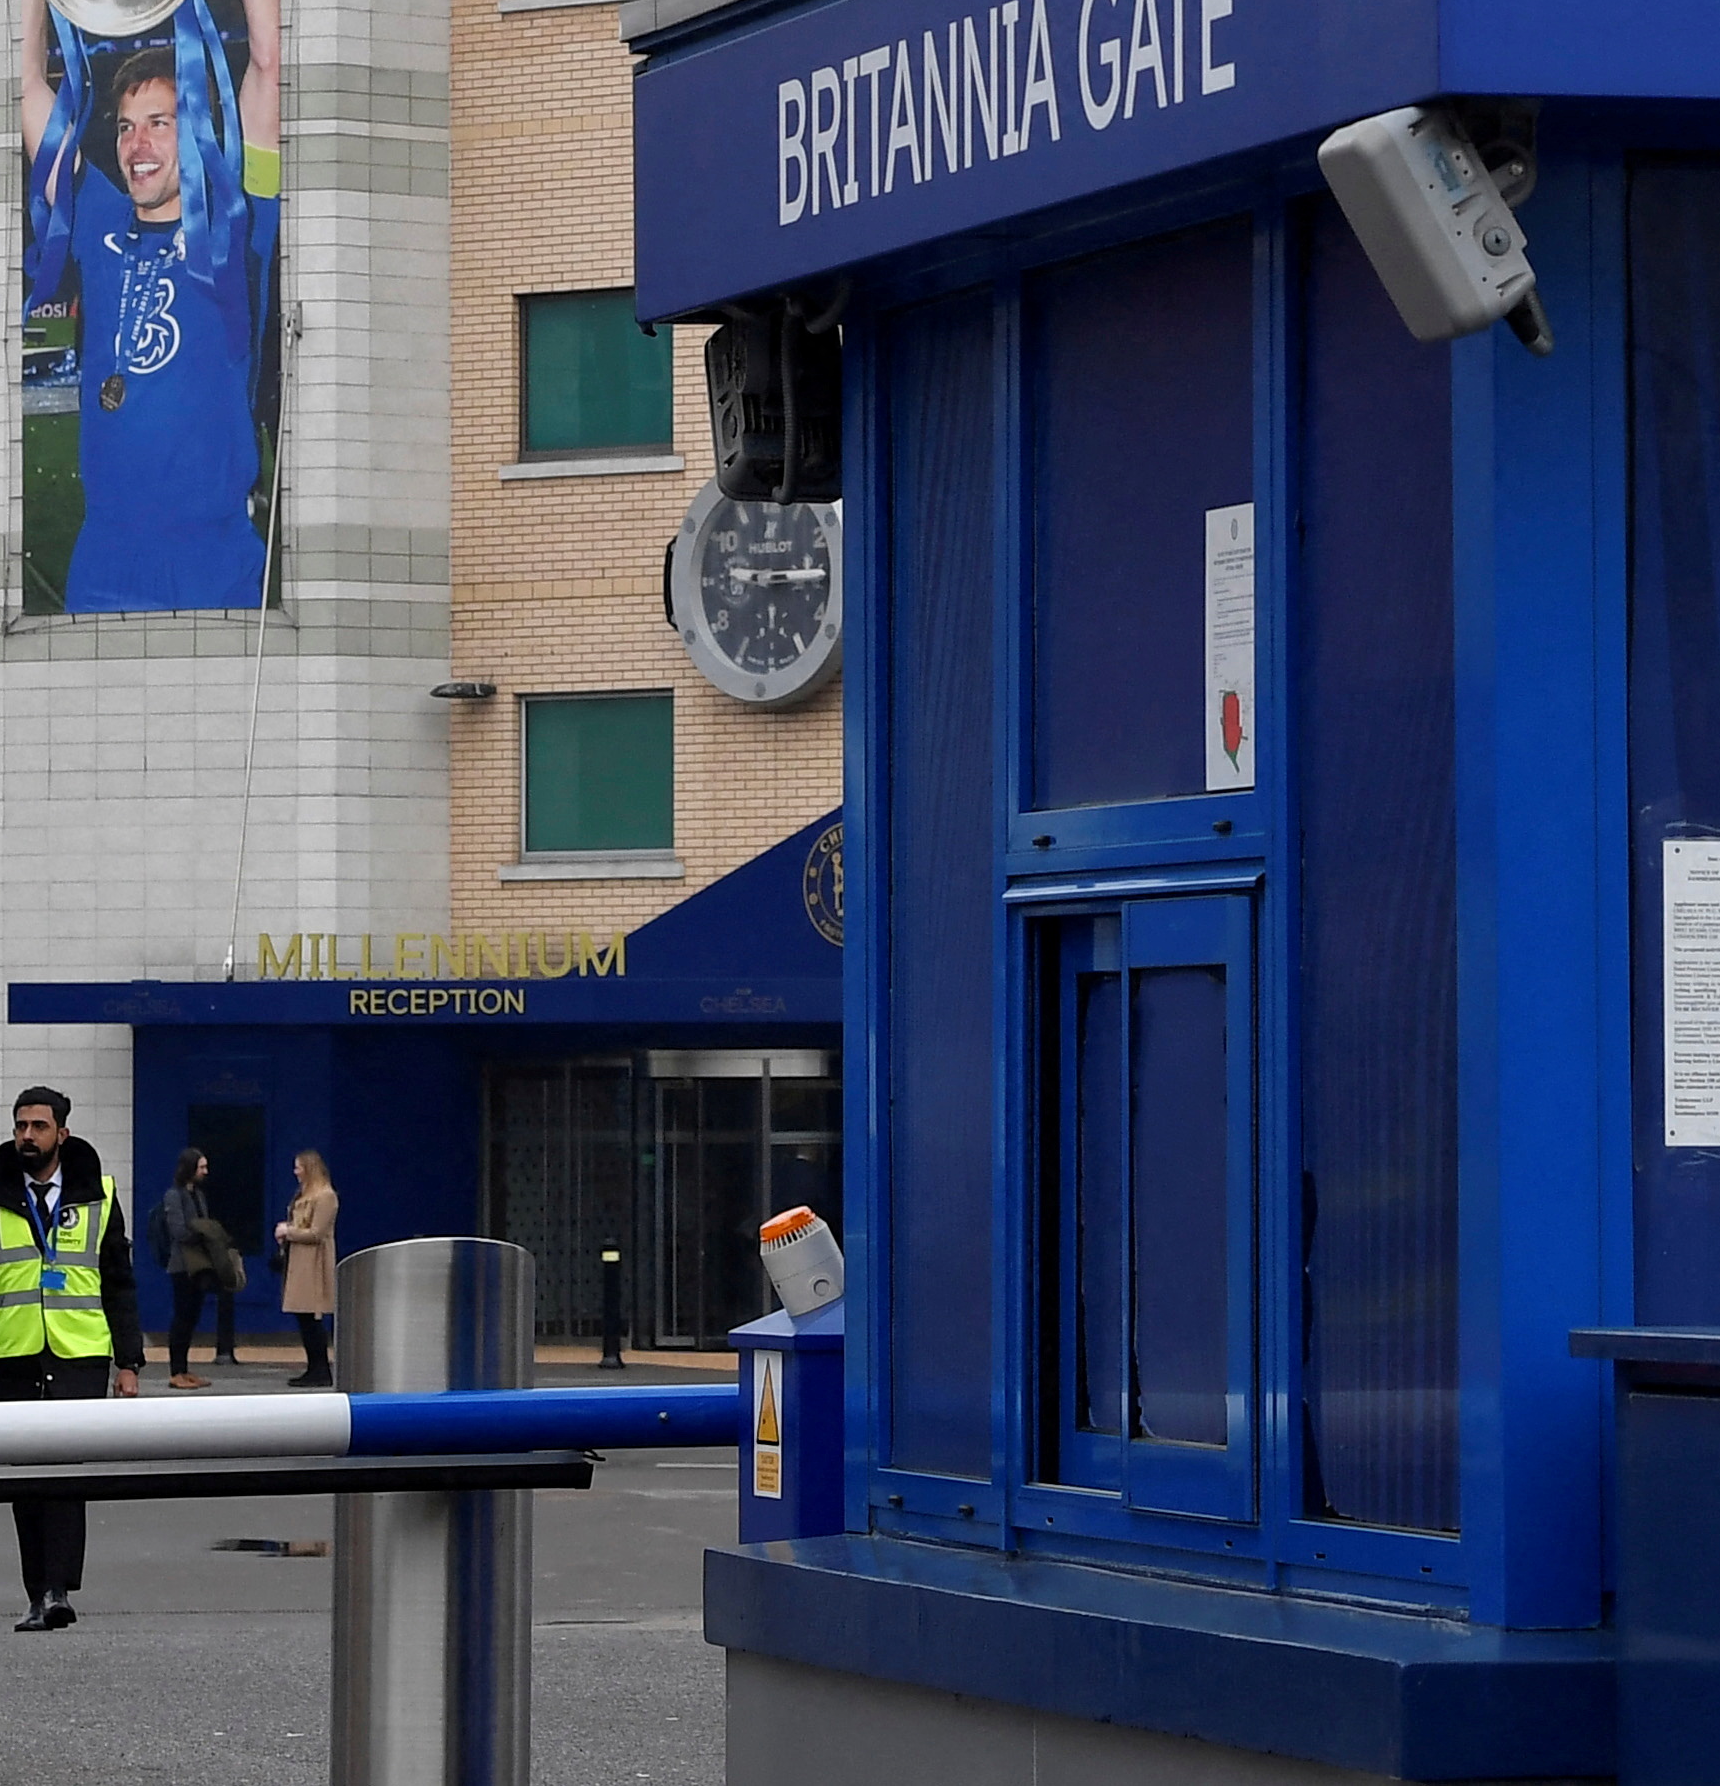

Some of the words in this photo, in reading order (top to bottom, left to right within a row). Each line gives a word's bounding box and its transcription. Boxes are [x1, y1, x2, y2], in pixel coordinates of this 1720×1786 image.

[748, 540, 793, 554] HUBLOT
[257, 932, 627, 979] MILLENNIUM
[349, 988, 526, 1017] RECEPTION
[700, 996, 787, 1014] CHELSEA
